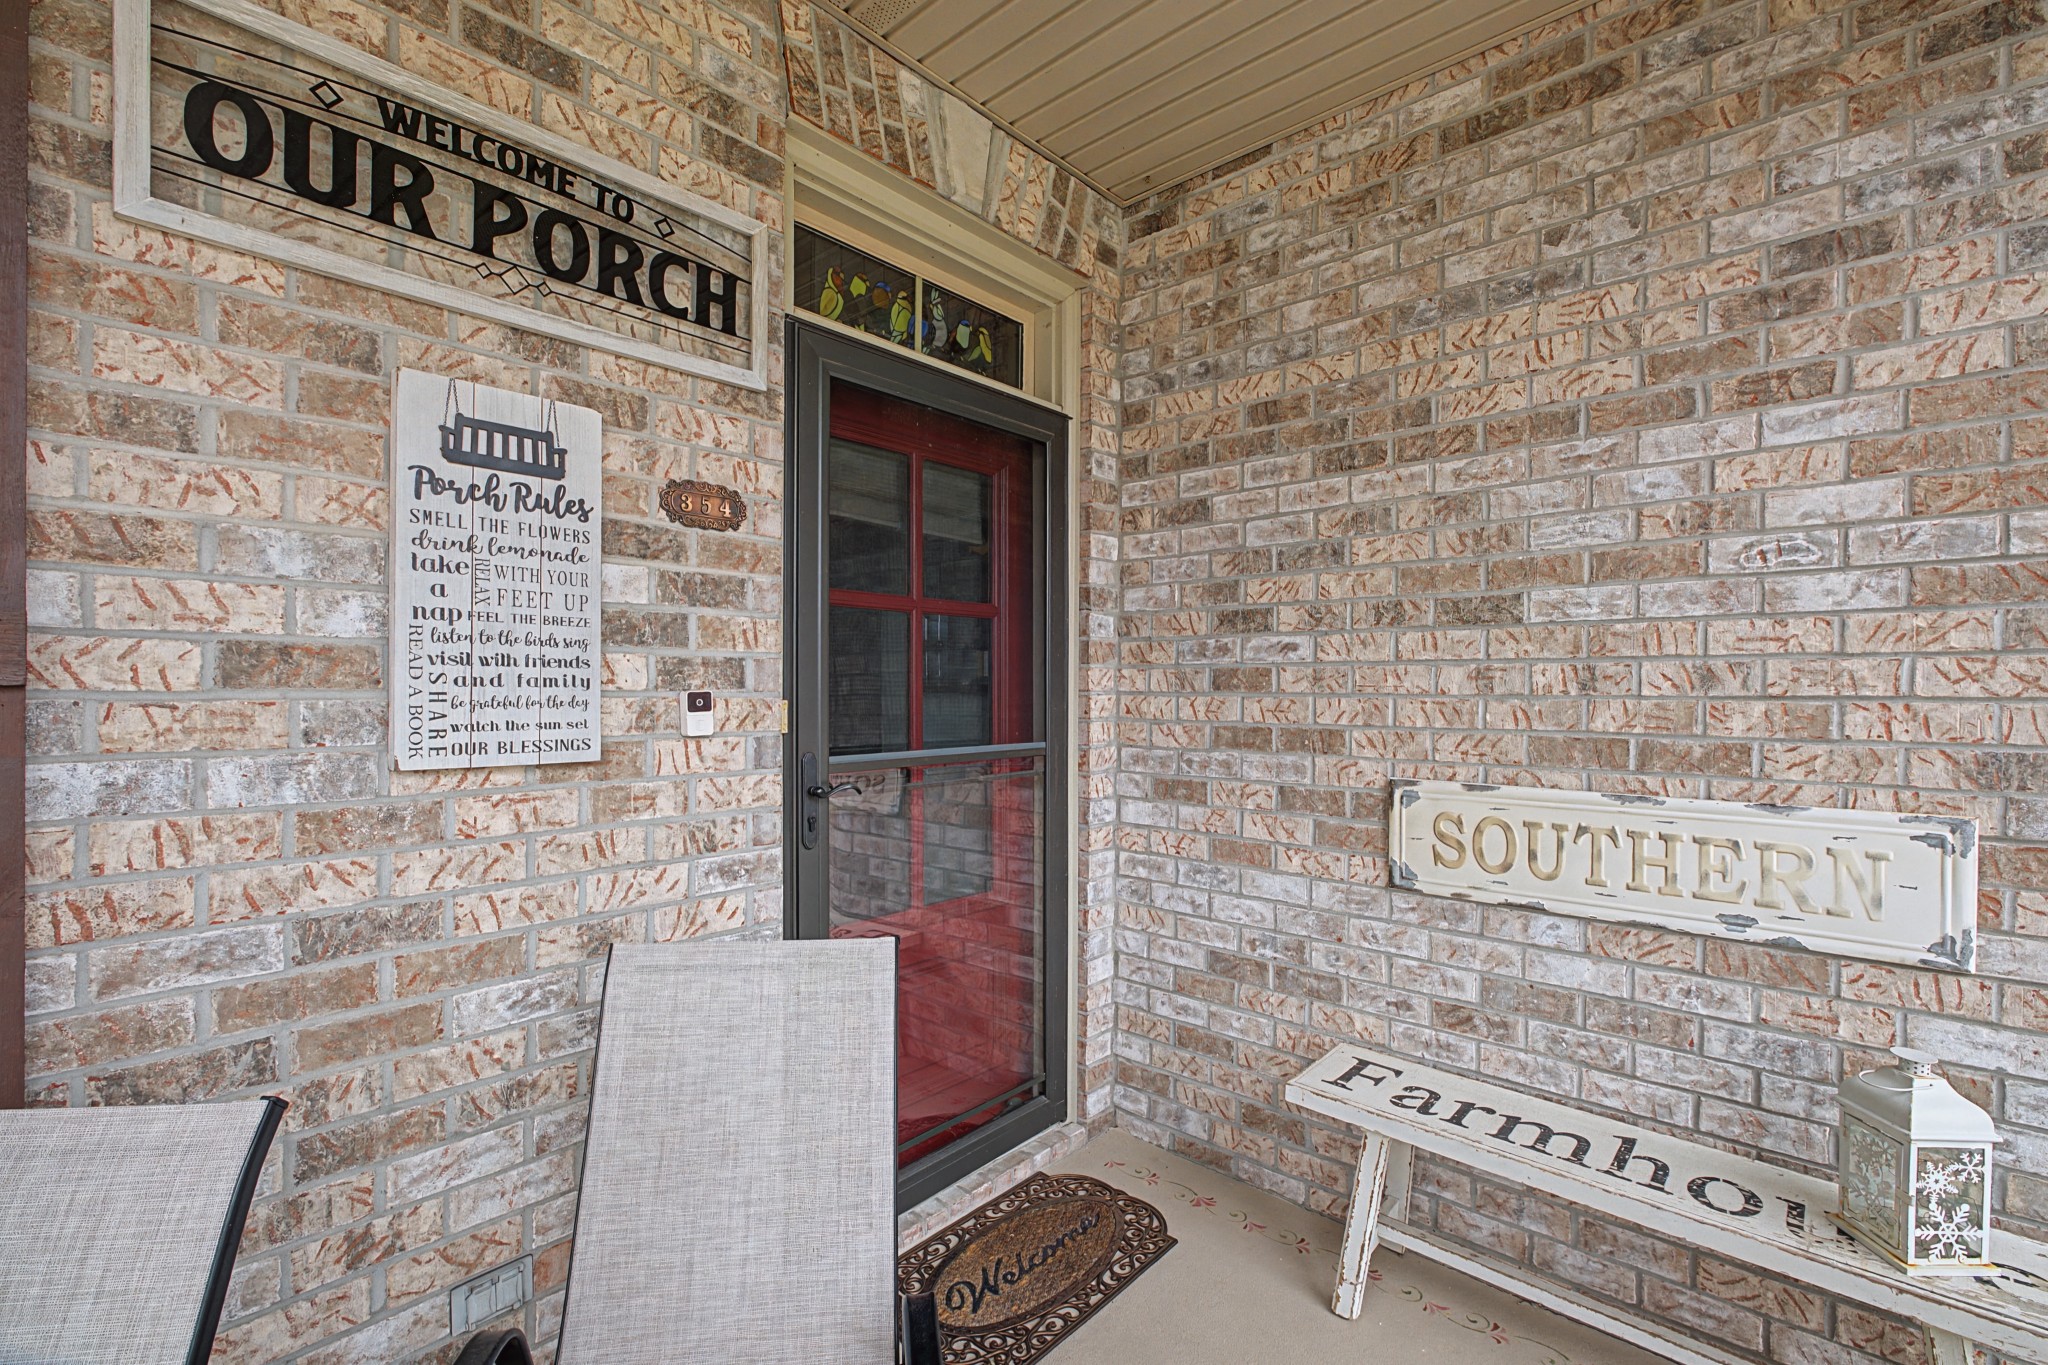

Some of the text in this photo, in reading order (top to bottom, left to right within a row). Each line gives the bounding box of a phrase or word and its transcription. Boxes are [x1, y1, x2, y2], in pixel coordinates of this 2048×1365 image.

[374, 94, 635, 225] WELCOME TO
[183, 79, 740, 337] OUR PORCH
[408, 465, 594, 523] Porch Rules
[681, 493, 731, 518] 354
[409, 508, 591, 545] SMELL THE FLOWERS
[411, 529, 590, 565] drink lemonade
[411, 552, 470, 575] take
[494, 564, 589, 588] WITH YOUR
[430, 583, 448, 598] a
[474, 557, 491, 606] RELAX
[497, 588, 589, 612] FEET UP
[412, 605, 463, 626] nap
[467, 610, 591, 628] FEEL THE BREEZE
[430, 627, 591, 652] listen to the birds sing
[427, 650, 591, 669] visit with friends
[408, 623, 424, 760] READ A BOOK
[453, 672, 591, 691] and family
[428, 672, 448, 758] SHARE
[450, 695, 467, 710] be
[469, 695, 523, 713] grateful
[525, 695, 543, 710] for
[542, 695, 565, 710] the
[450, 720, 501, 733] watch
[505, 719, 530, 732] the
[451, 737, 592, 756] OUR BLESSINGS
[1432, 810, 1893, 922] SOUTHERN
[1320, 1056, 2048, 1290] Farmhou
[945, 1214, 1099, 1314] Welcome
